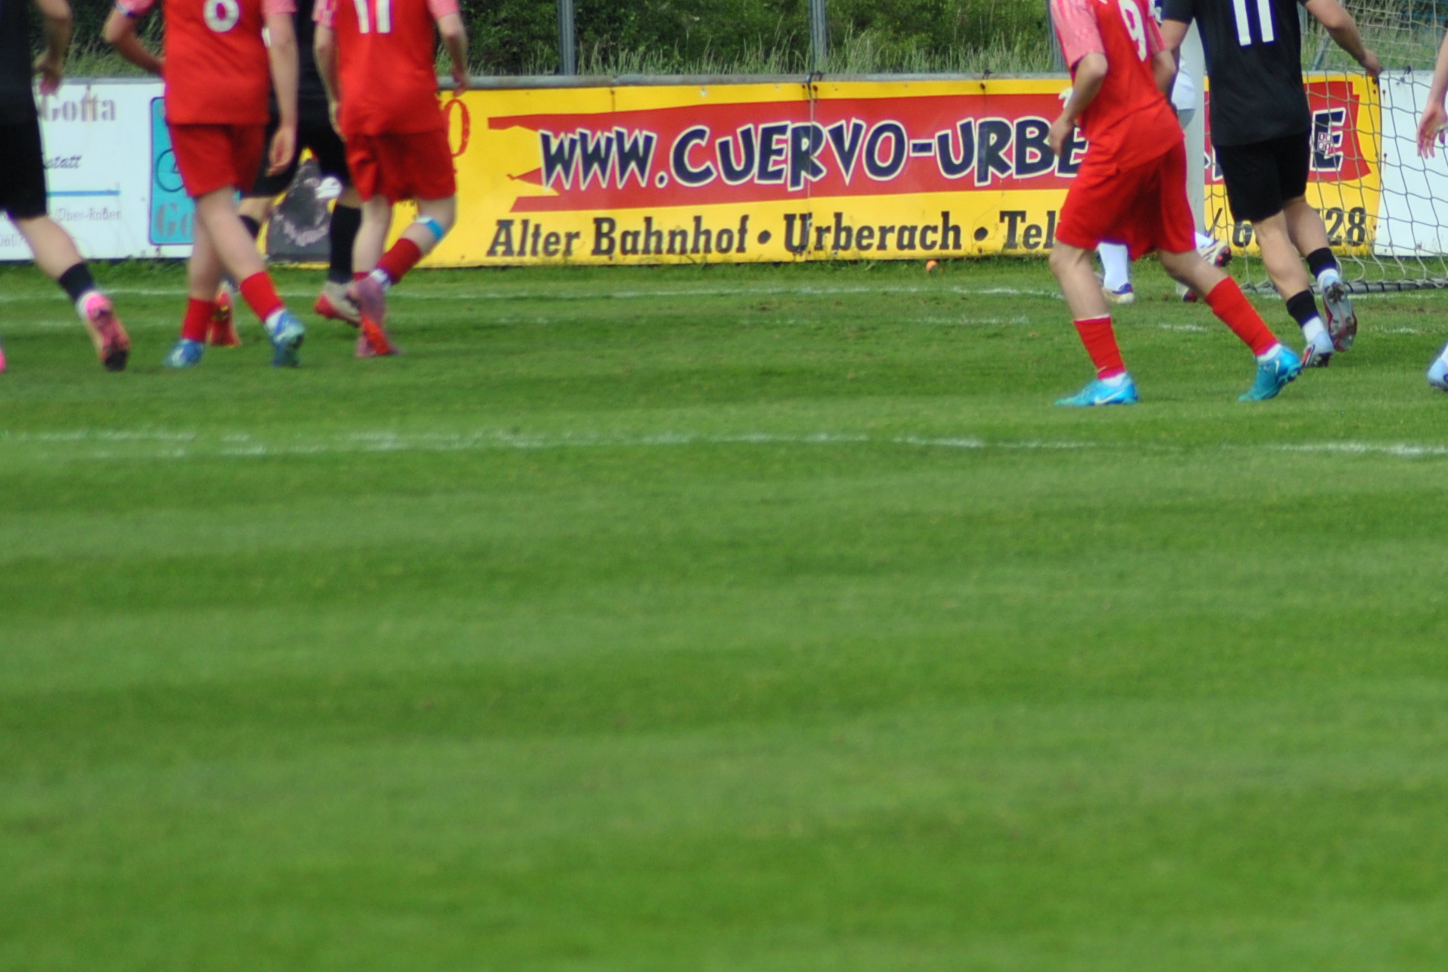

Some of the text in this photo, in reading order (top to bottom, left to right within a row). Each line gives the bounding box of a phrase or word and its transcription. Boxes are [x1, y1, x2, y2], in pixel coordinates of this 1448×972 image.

[486, 218, 581, 257] Alter
[591, 214, 750, 257] Bahnhof
[783, 210, 963, 253] Urberach
